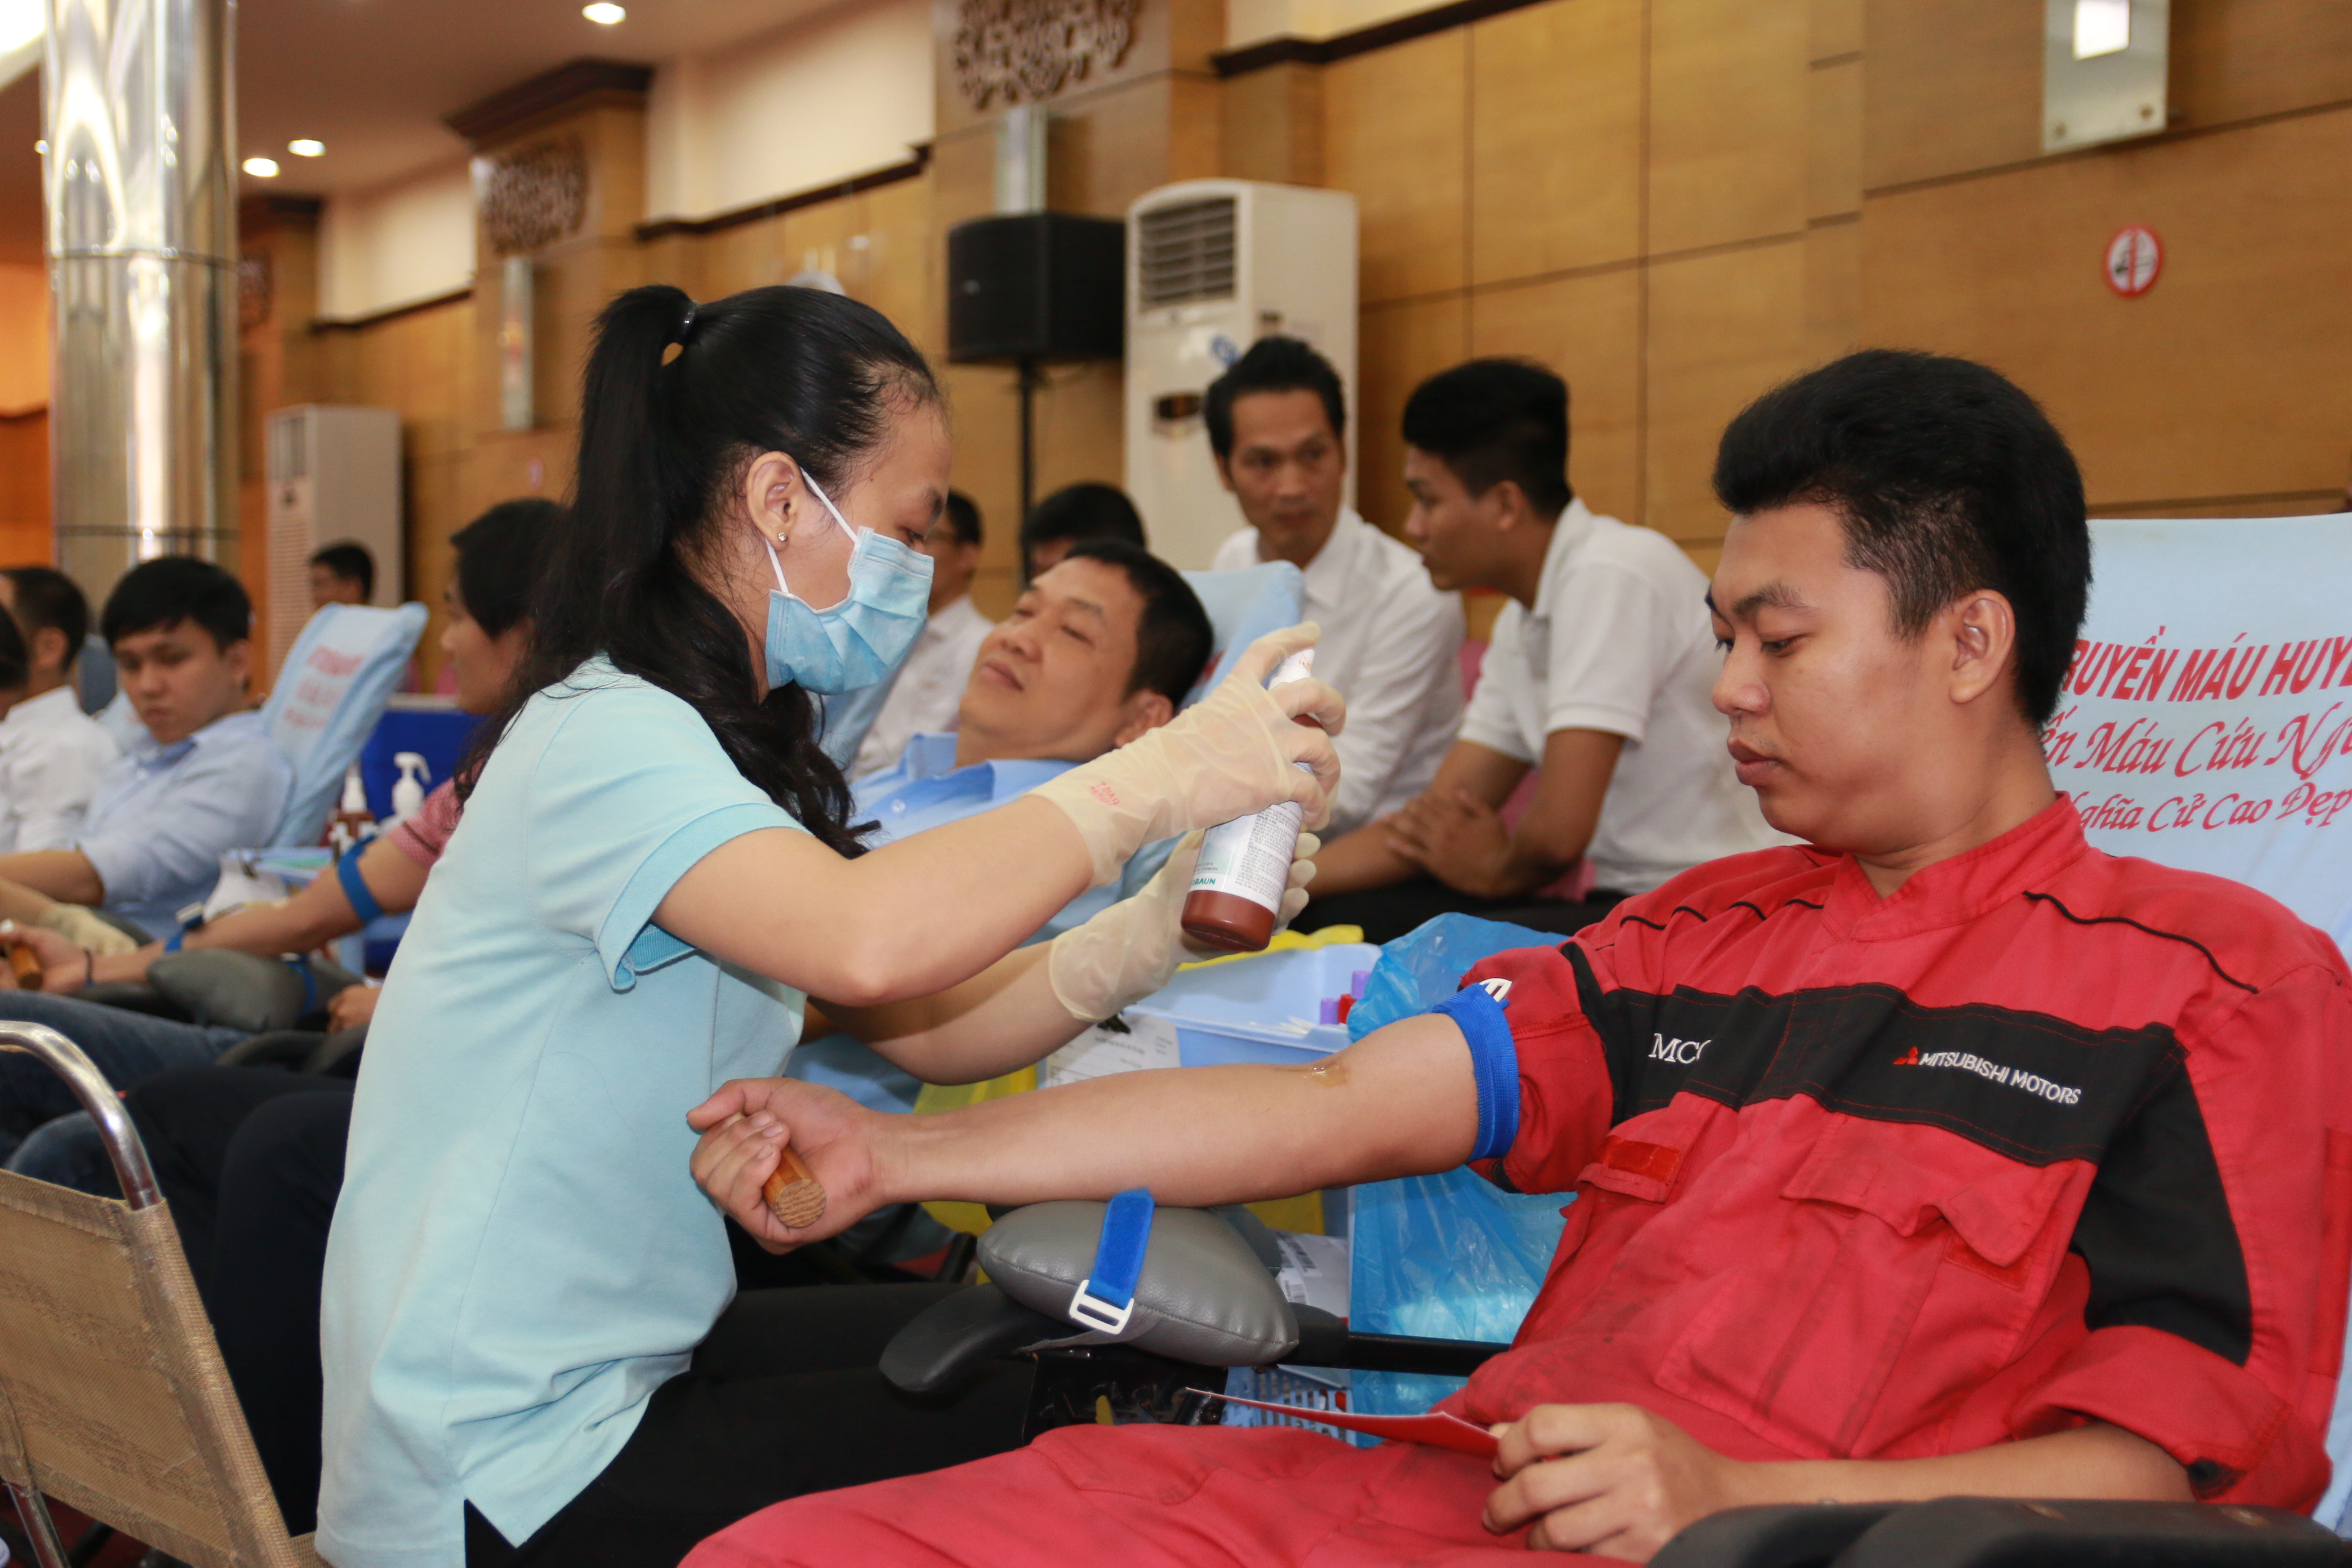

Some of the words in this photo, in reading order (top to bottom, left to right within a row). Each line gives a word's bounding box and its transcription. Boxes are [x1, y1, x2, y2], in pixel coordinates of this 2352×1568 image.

[2167, 632, 2269, 702] MÁU
[2258, 634, 2352, 696] HUY
[2073, 717, 2175, 774] Máu
[2175, 716, 2268, 778] Cứu
[2073, 791, 2145, 830] ghĩa
[2147, 793, 2206, 832] Cử
[2202, 793, 2273, 830] Cao
[2275, 781, 2352, 828] Đẹp
[1919, 1052, 2010, 1083] MITSUBISHI
[2010, 1070, 2082, 1104] MOTORS
